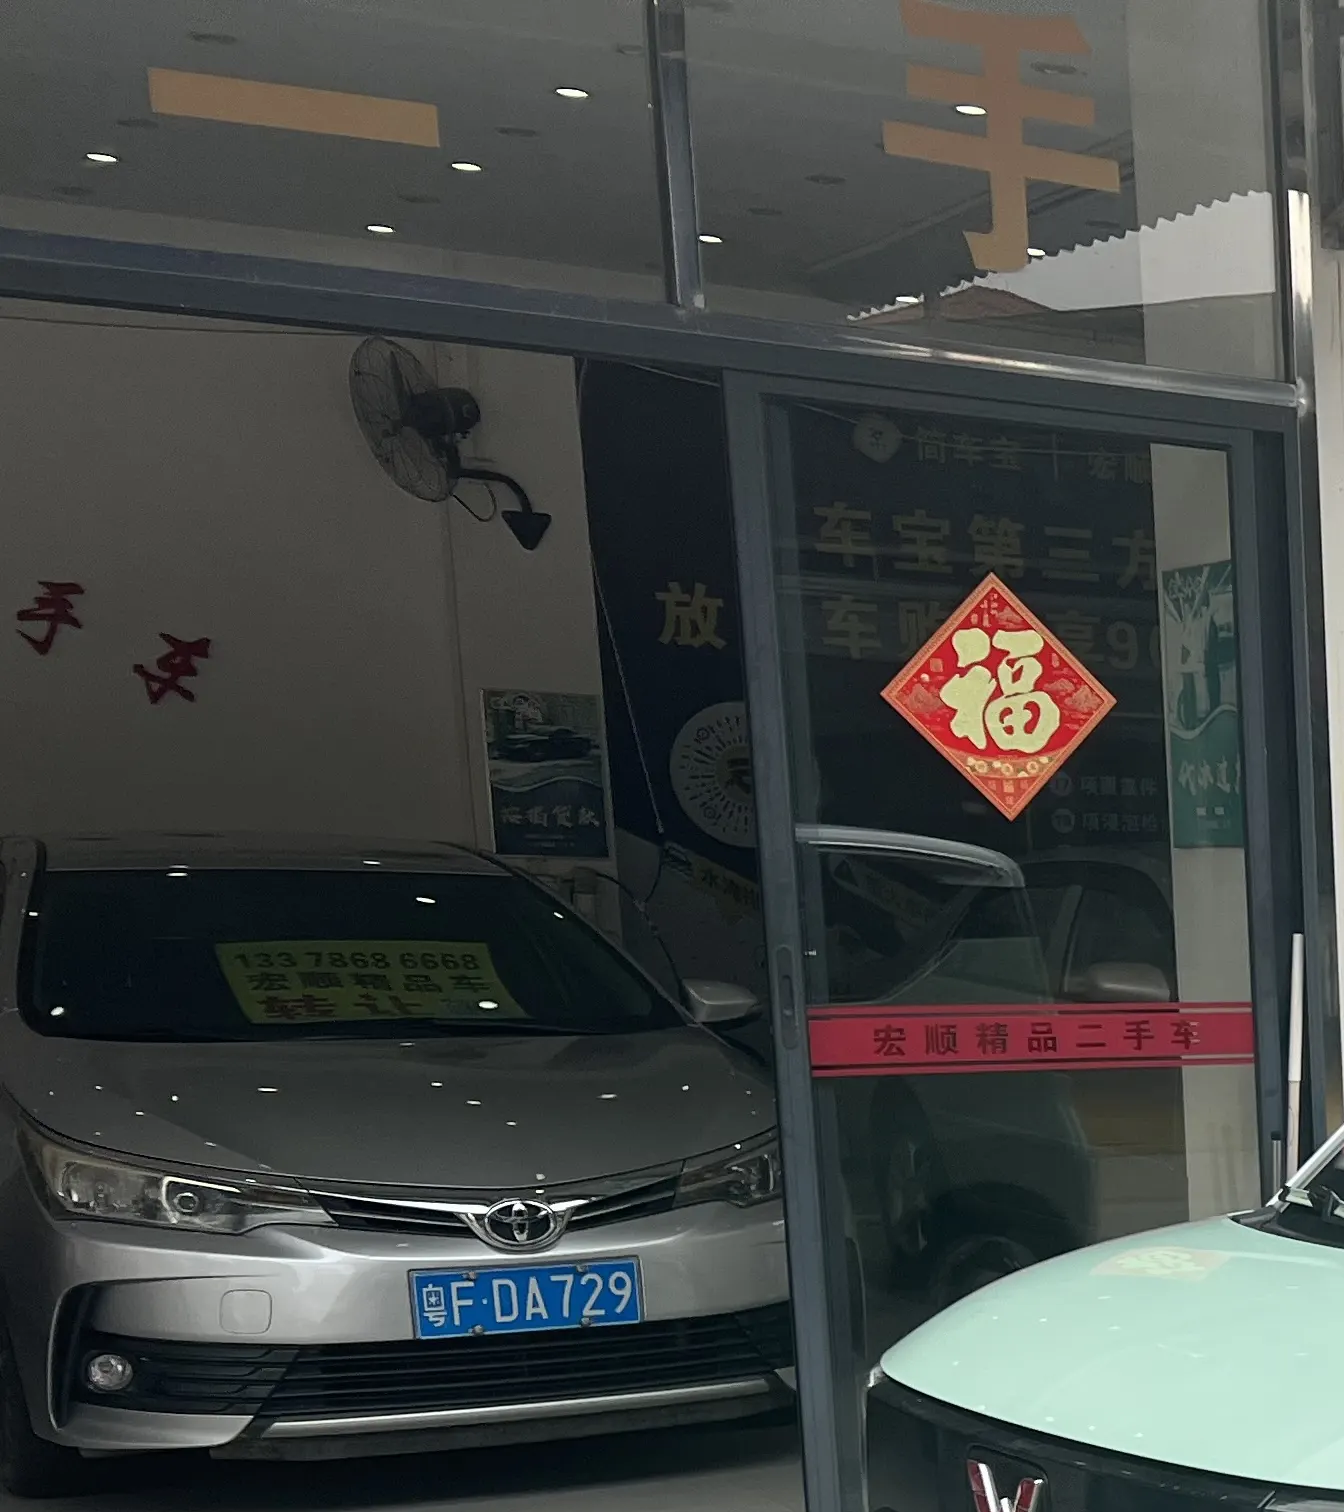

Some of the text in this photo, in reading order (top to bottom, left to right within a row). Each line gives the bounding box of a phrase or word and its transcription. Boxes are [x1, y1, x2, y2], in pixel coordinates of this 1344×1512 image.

[882, 0, 1120, 275] 手
[655, 581, 728, 649] 放
[940, 627, 1062, 754] 福
[234, 951, 481, 971] 133 7868 6668
[256, 994, 434, 1019] 转让
[872, 1018, 1202, 1059] 宏顺精品二手车
